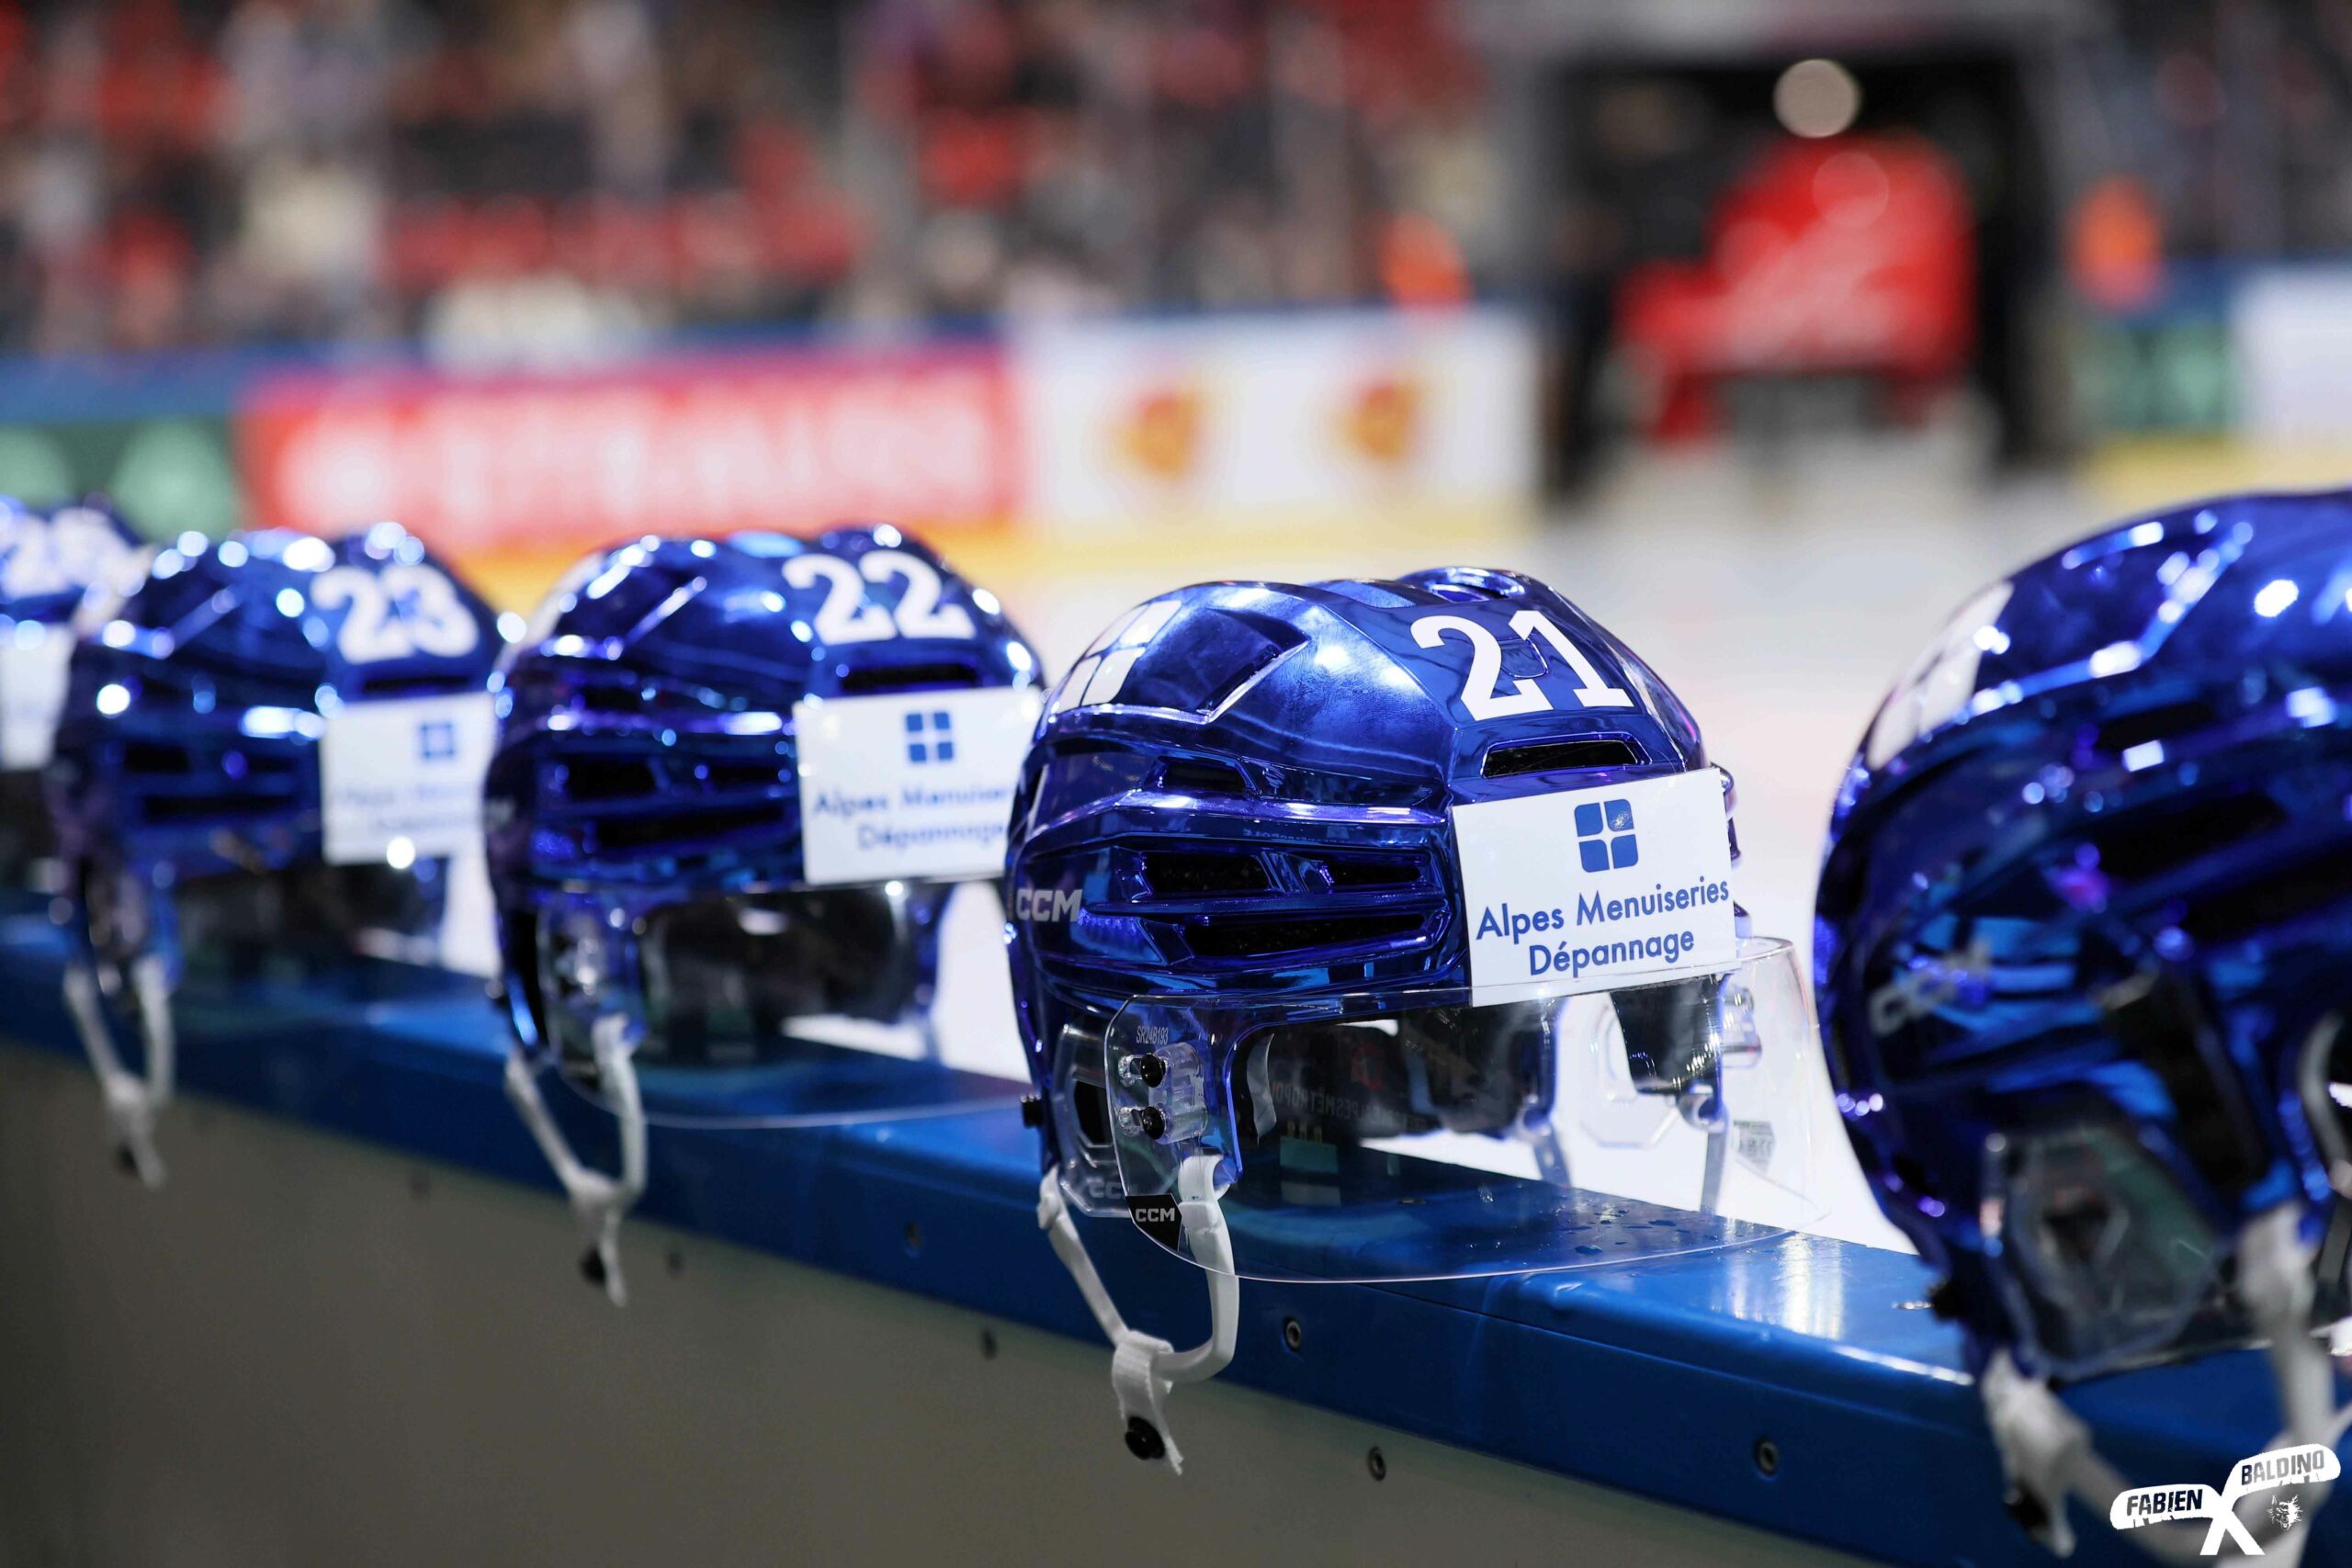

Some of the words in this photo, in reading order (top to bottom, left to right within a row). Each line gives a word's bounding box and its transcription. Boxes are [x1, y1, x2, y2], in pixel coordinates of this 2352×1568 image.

[311, 564, 479, 665] 23
[782, 550, 978, 647] 22
[1410, 610, 1634, 721] 21
[1015, 888, 1083, 922] CCM
[1476, 902, 1566, 945] Alpes
[1577, 875, 1730, 926] Menuiseries
[1529, 931, 1695, 978] Dépannage
[1135, 1207, 1175, 1223] CCM
